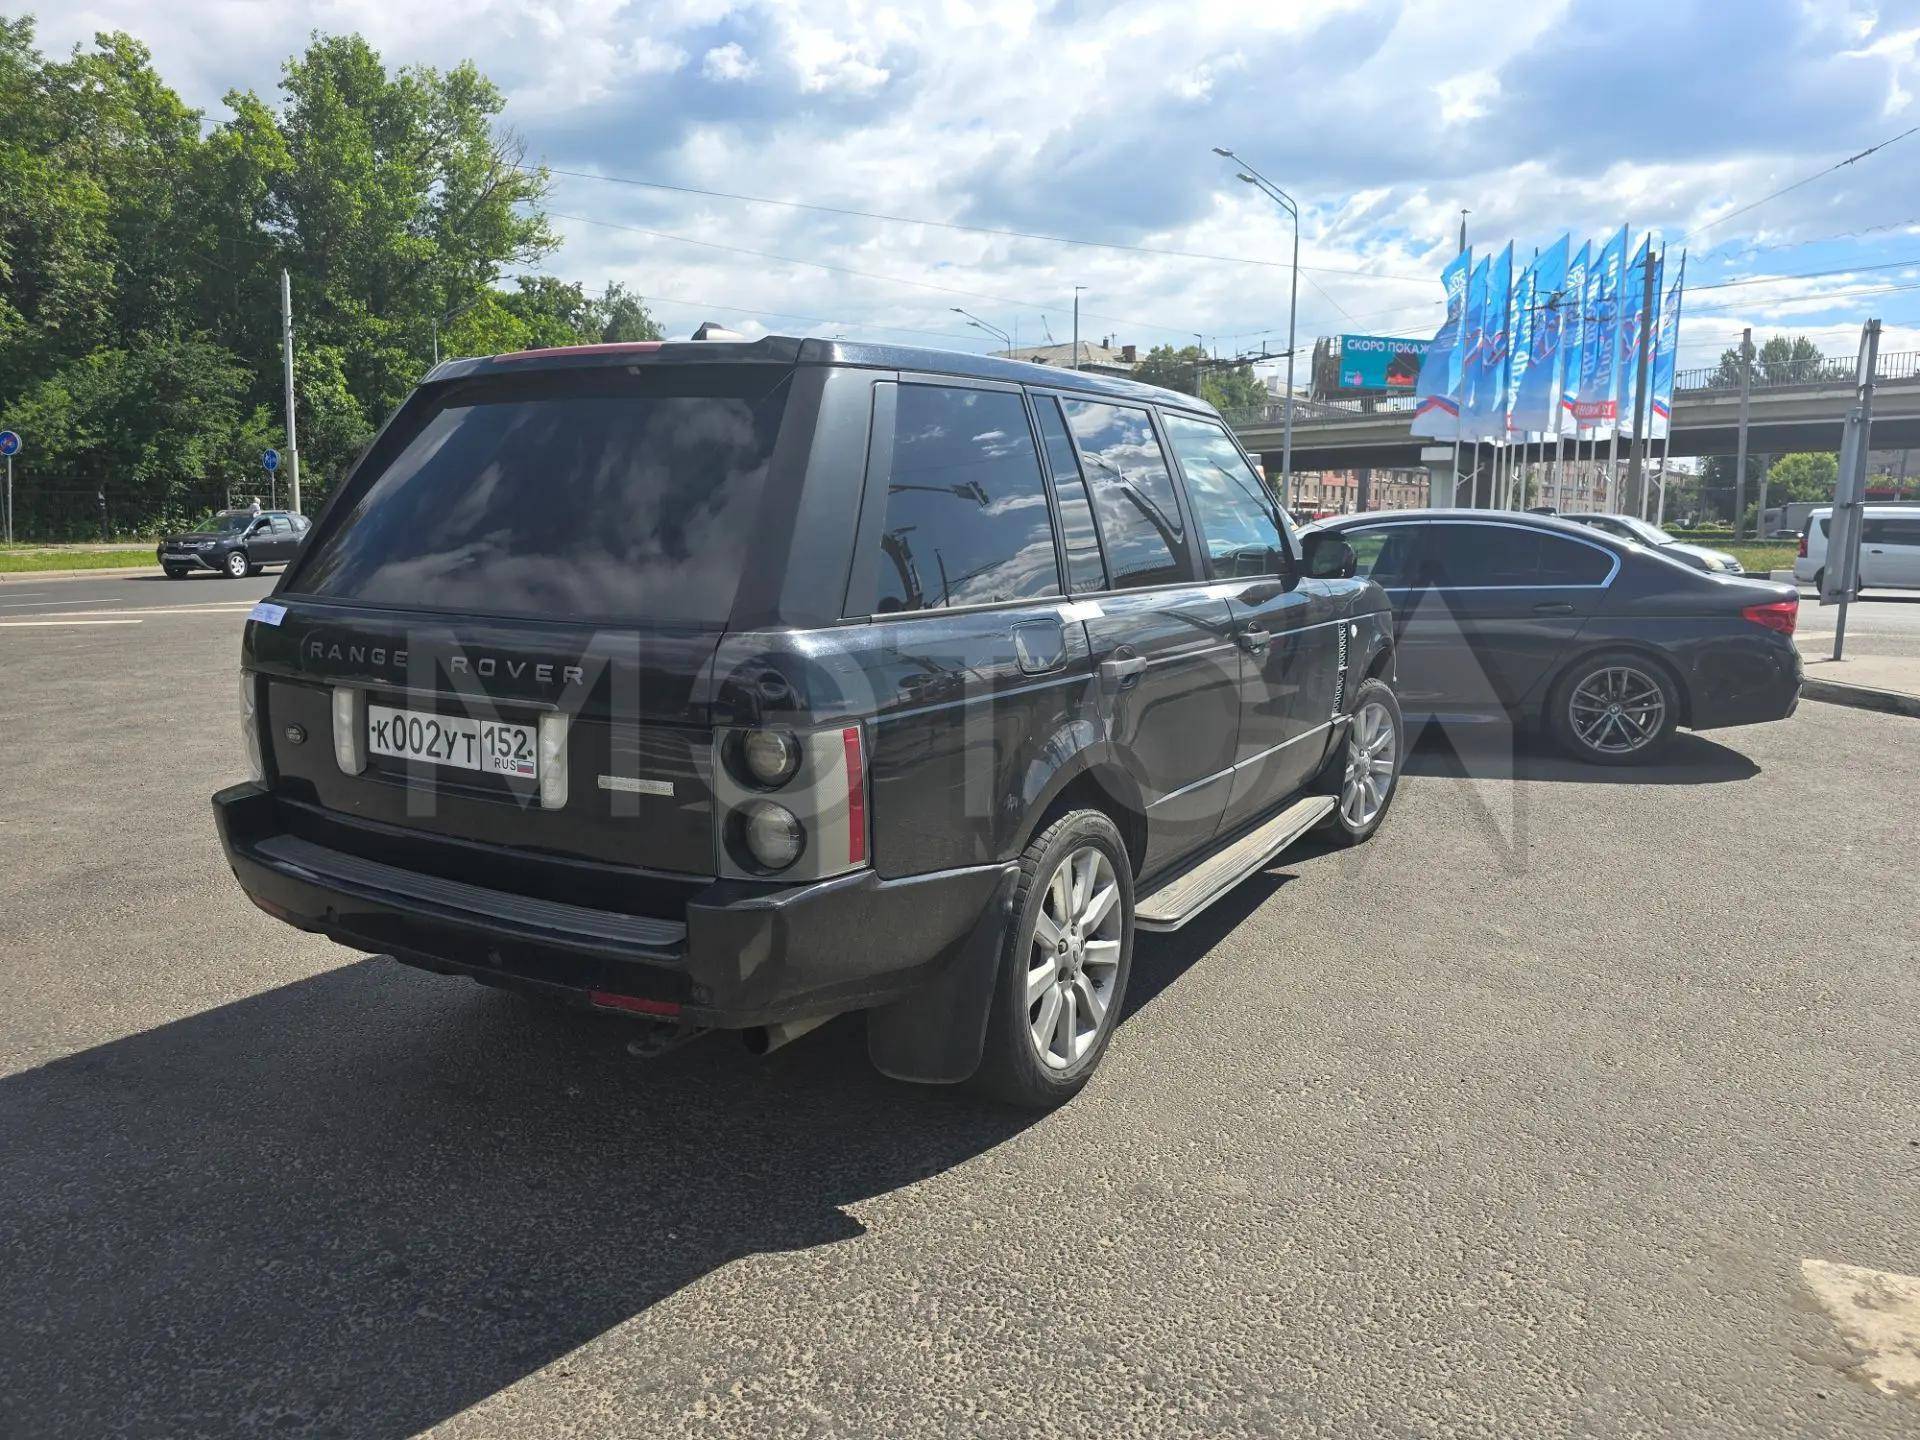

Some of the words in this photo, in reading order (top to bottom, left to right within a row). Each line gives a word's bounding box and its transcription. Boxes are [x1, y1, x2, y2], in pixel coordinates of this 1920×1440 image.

[1347, 339, 1385, 352] СКОРО
[310, 641, 408, 668] RANGE
[450, 655, 585, 686] ROVER
[483, 725, 528, 760] 152
[494, 757, 517, 771] RUS
